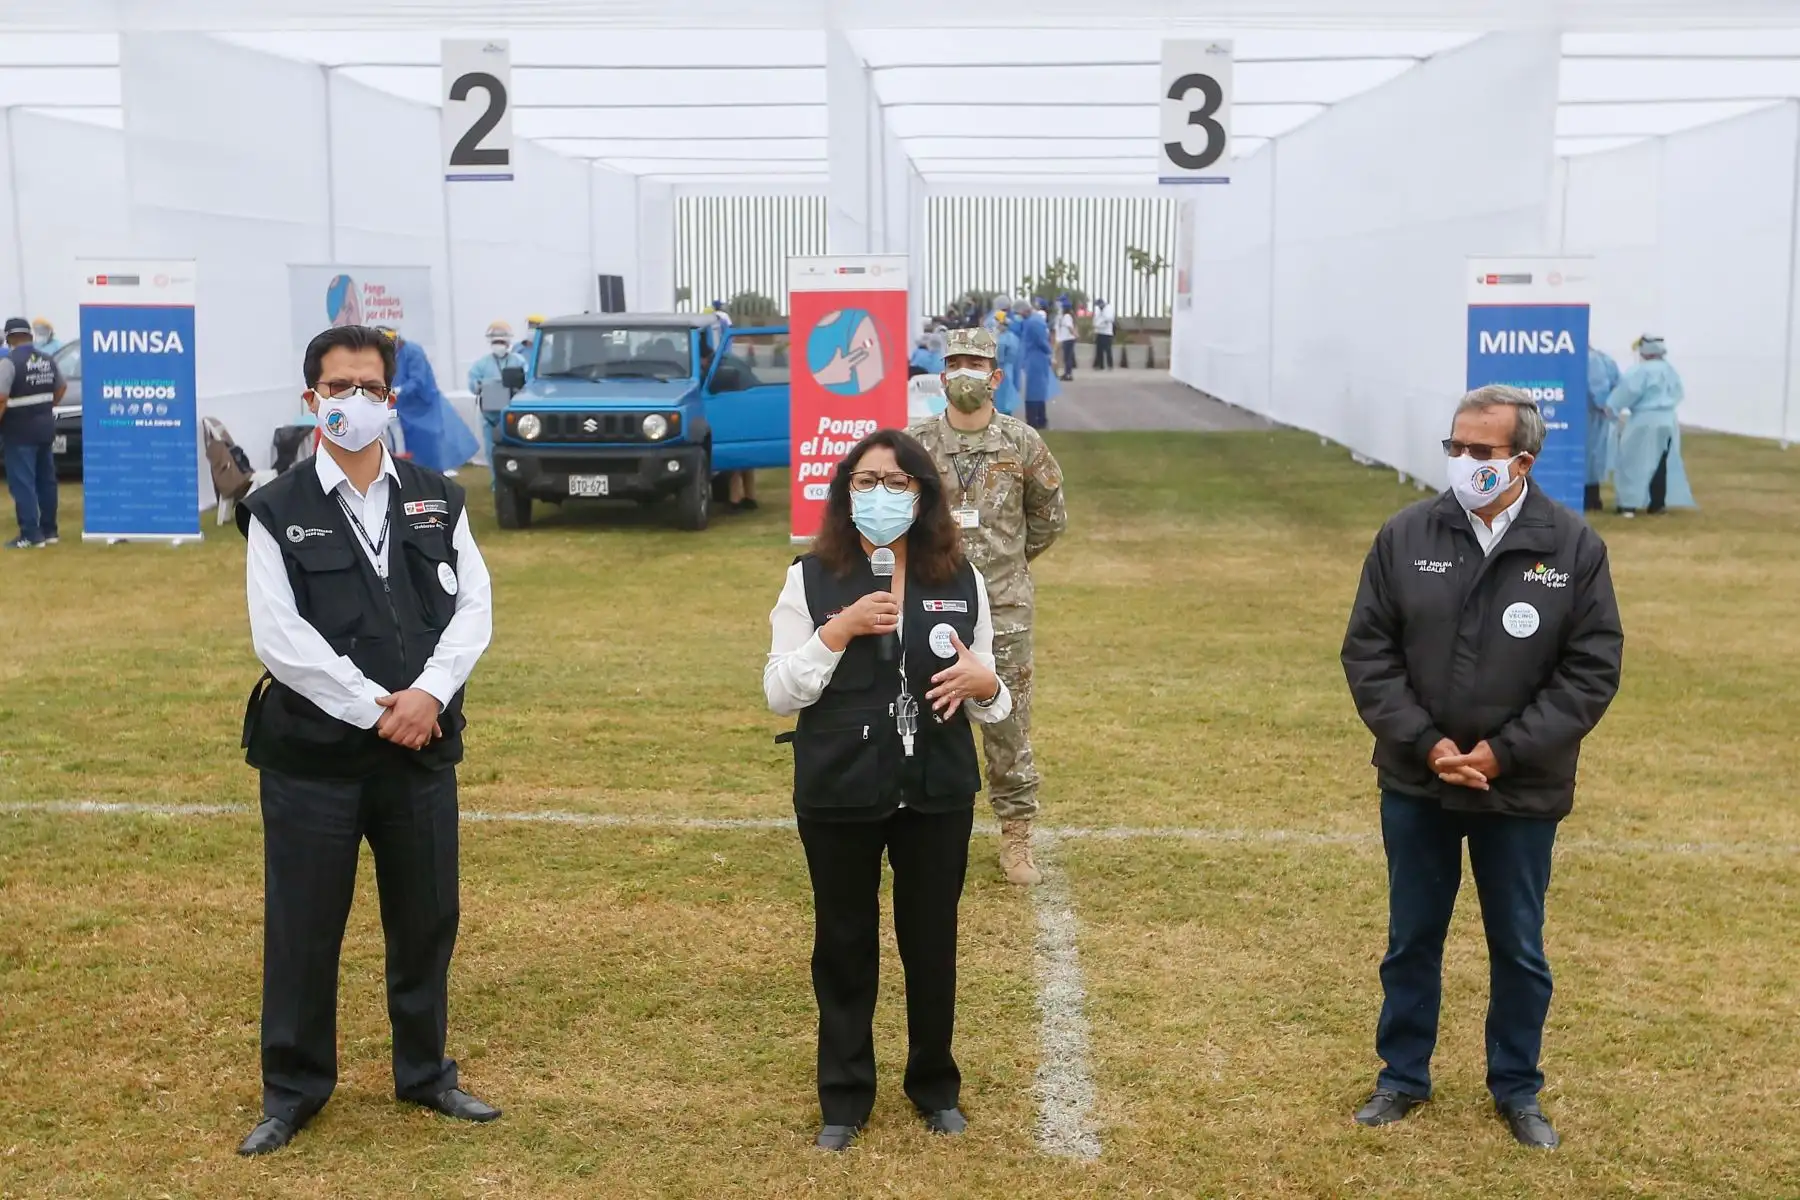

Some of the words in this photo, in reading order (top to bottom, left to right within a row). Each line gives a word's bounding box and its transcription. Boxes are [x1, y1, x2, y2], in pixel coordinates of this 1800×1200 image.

[449, 72, 509, 166] 2
[1164, 73, 1226, 170] 3
[93, 330, 184, 353] MINSA
[1480, 330, 1575, 354] MINSA
[103, 385, 122, 399] DE
[124, 385, 176, 399] TODOS
[818, 416, 877, 439] Pongo
[800, 436, 819, 455] el
[798, 461, 833, 482] por
[1418, 565, 1447, 573] ALCALDE
[1429, 560, 1453, 568] MOLINA
[1523, 567, 1570, 585] Miraflores
